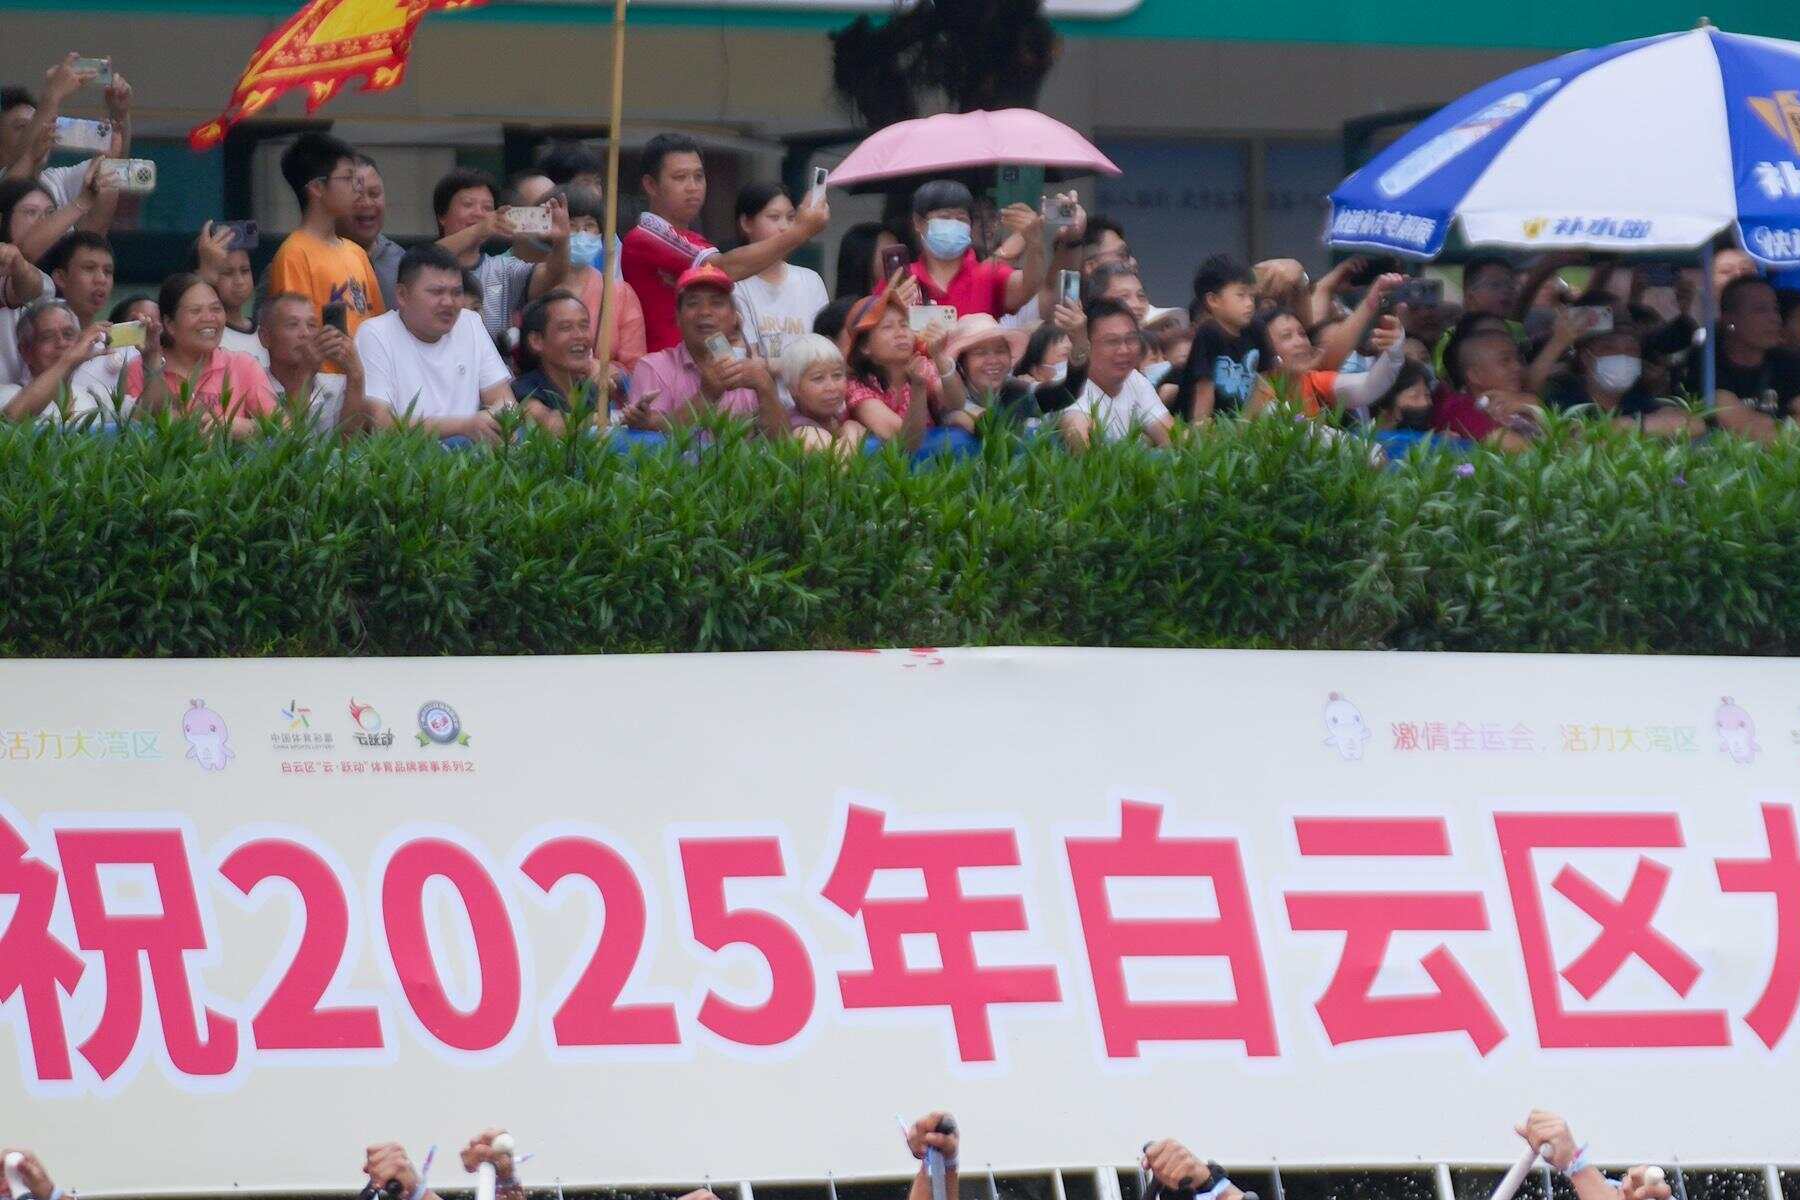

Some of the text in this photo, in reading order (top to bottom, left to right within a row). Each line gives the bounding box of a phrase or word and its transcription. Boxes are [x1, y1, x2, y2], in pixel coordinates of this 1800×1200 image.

[0, 729, 162, 761] 活力大湾区
